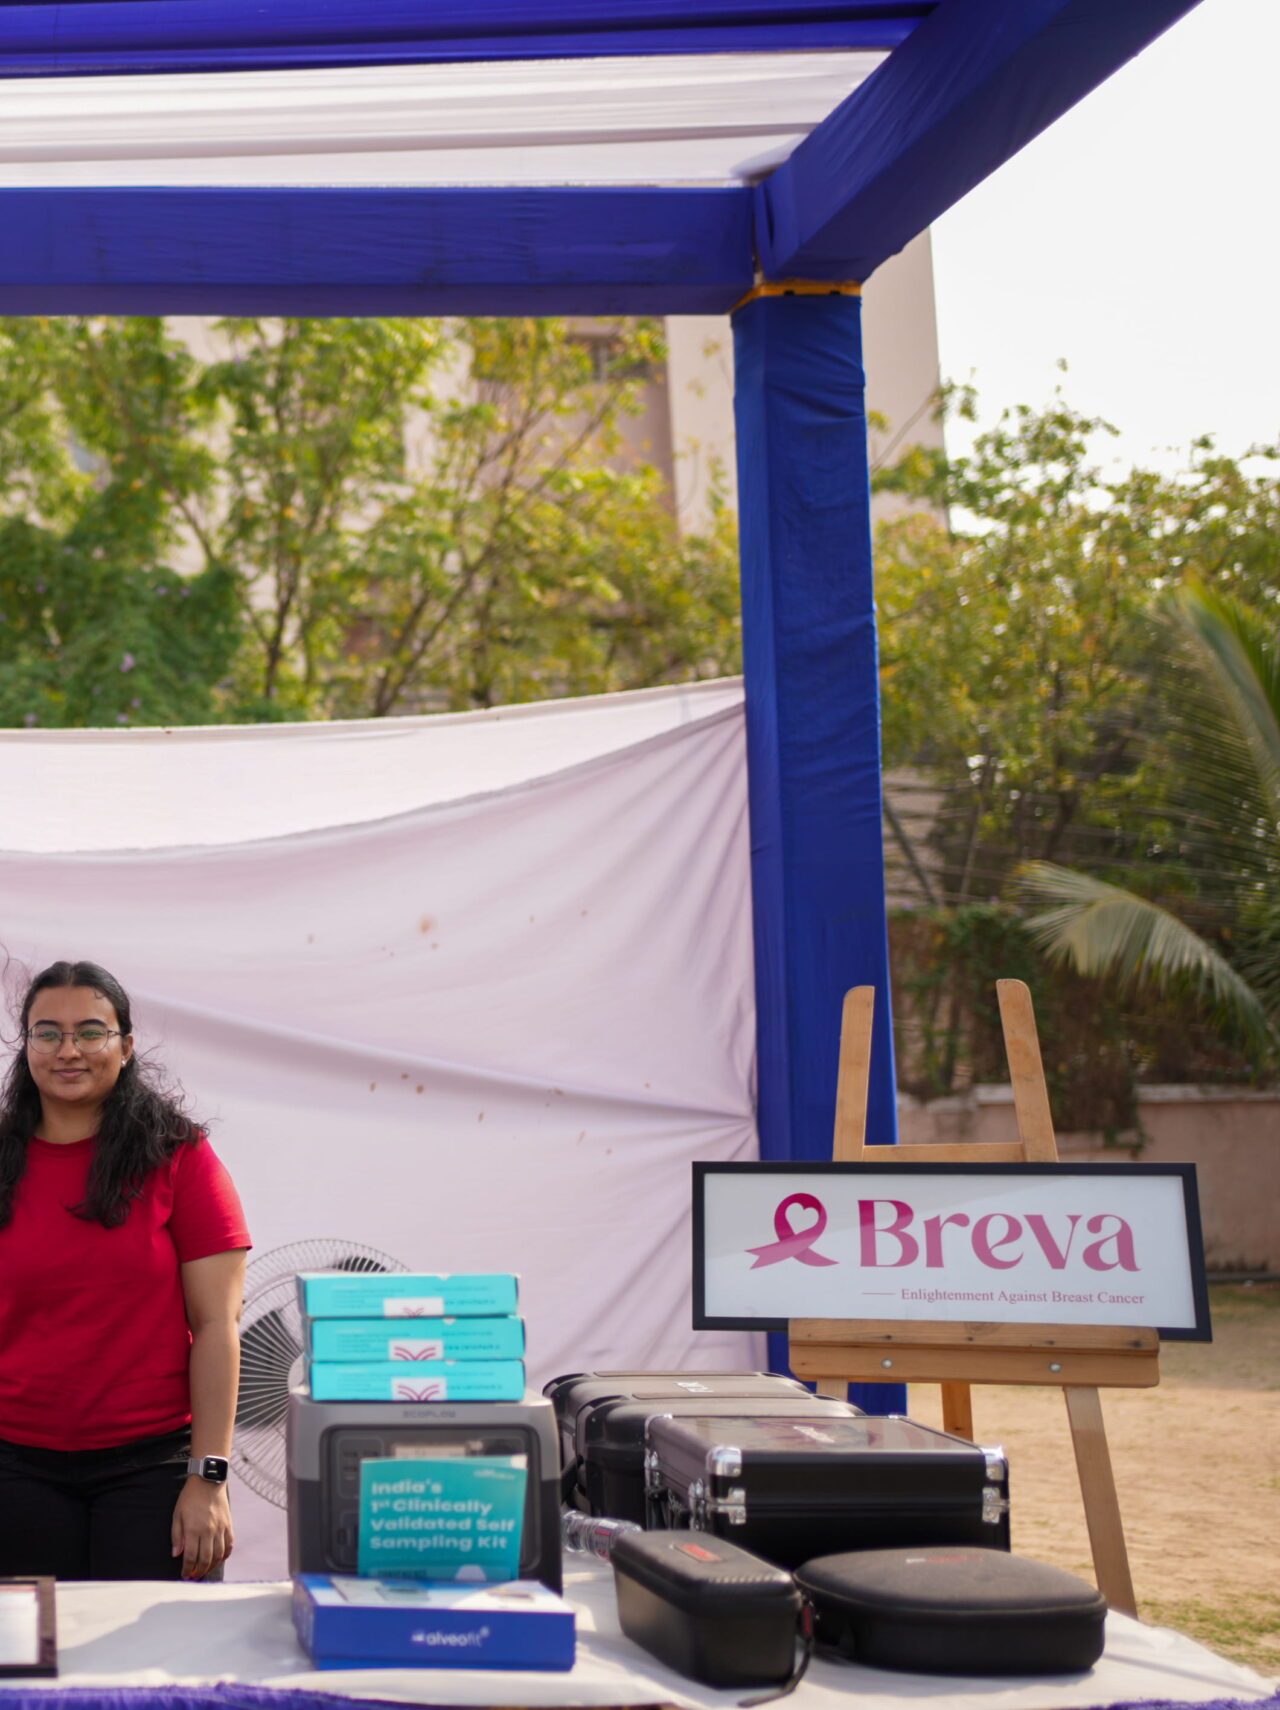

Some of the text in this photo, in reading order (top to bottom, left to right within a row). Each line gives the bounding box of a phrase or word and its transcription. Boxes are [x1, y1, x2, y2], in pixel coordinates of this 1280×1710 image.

[858, 1199, 1141, 1273] Breva
[901, 1289, 1144, 1306] Enlightenment Against Breast Cancer
[371, 1479, 443, 1496] India's
[393, 1498, 493, 1516] Clinically
[370, 1517, 515, 1532] Validated Self
[370, 1534, 508, 1552] Sampling Kit
